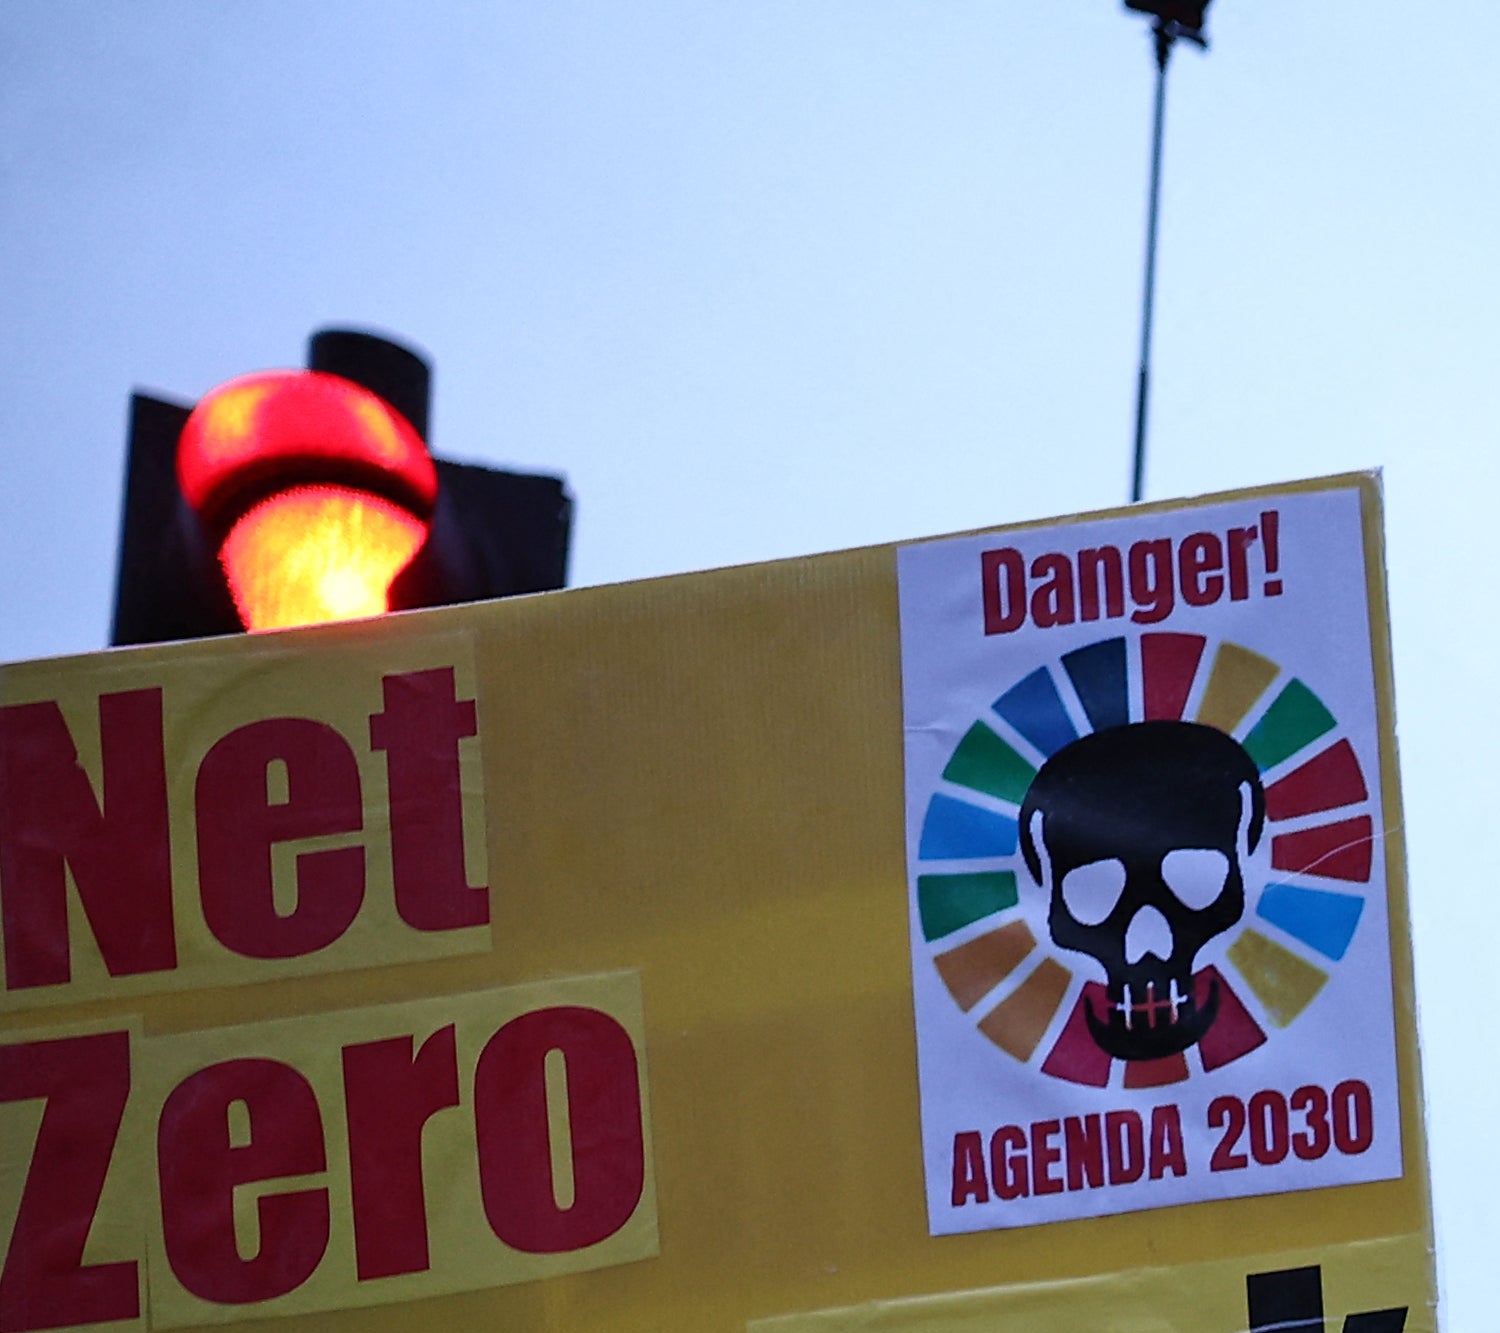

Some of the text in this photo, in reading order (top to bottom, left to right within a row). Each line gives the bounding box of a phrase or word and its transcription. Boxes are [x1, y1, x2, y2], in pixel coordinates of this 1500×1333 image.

[979, 510, 1284, 636] Danger!
[0, 665, 490, 991] Net
[0, 1005, 645, 1333] Zero
[950, 1079, 1374, 1208] AGENDA 2030
